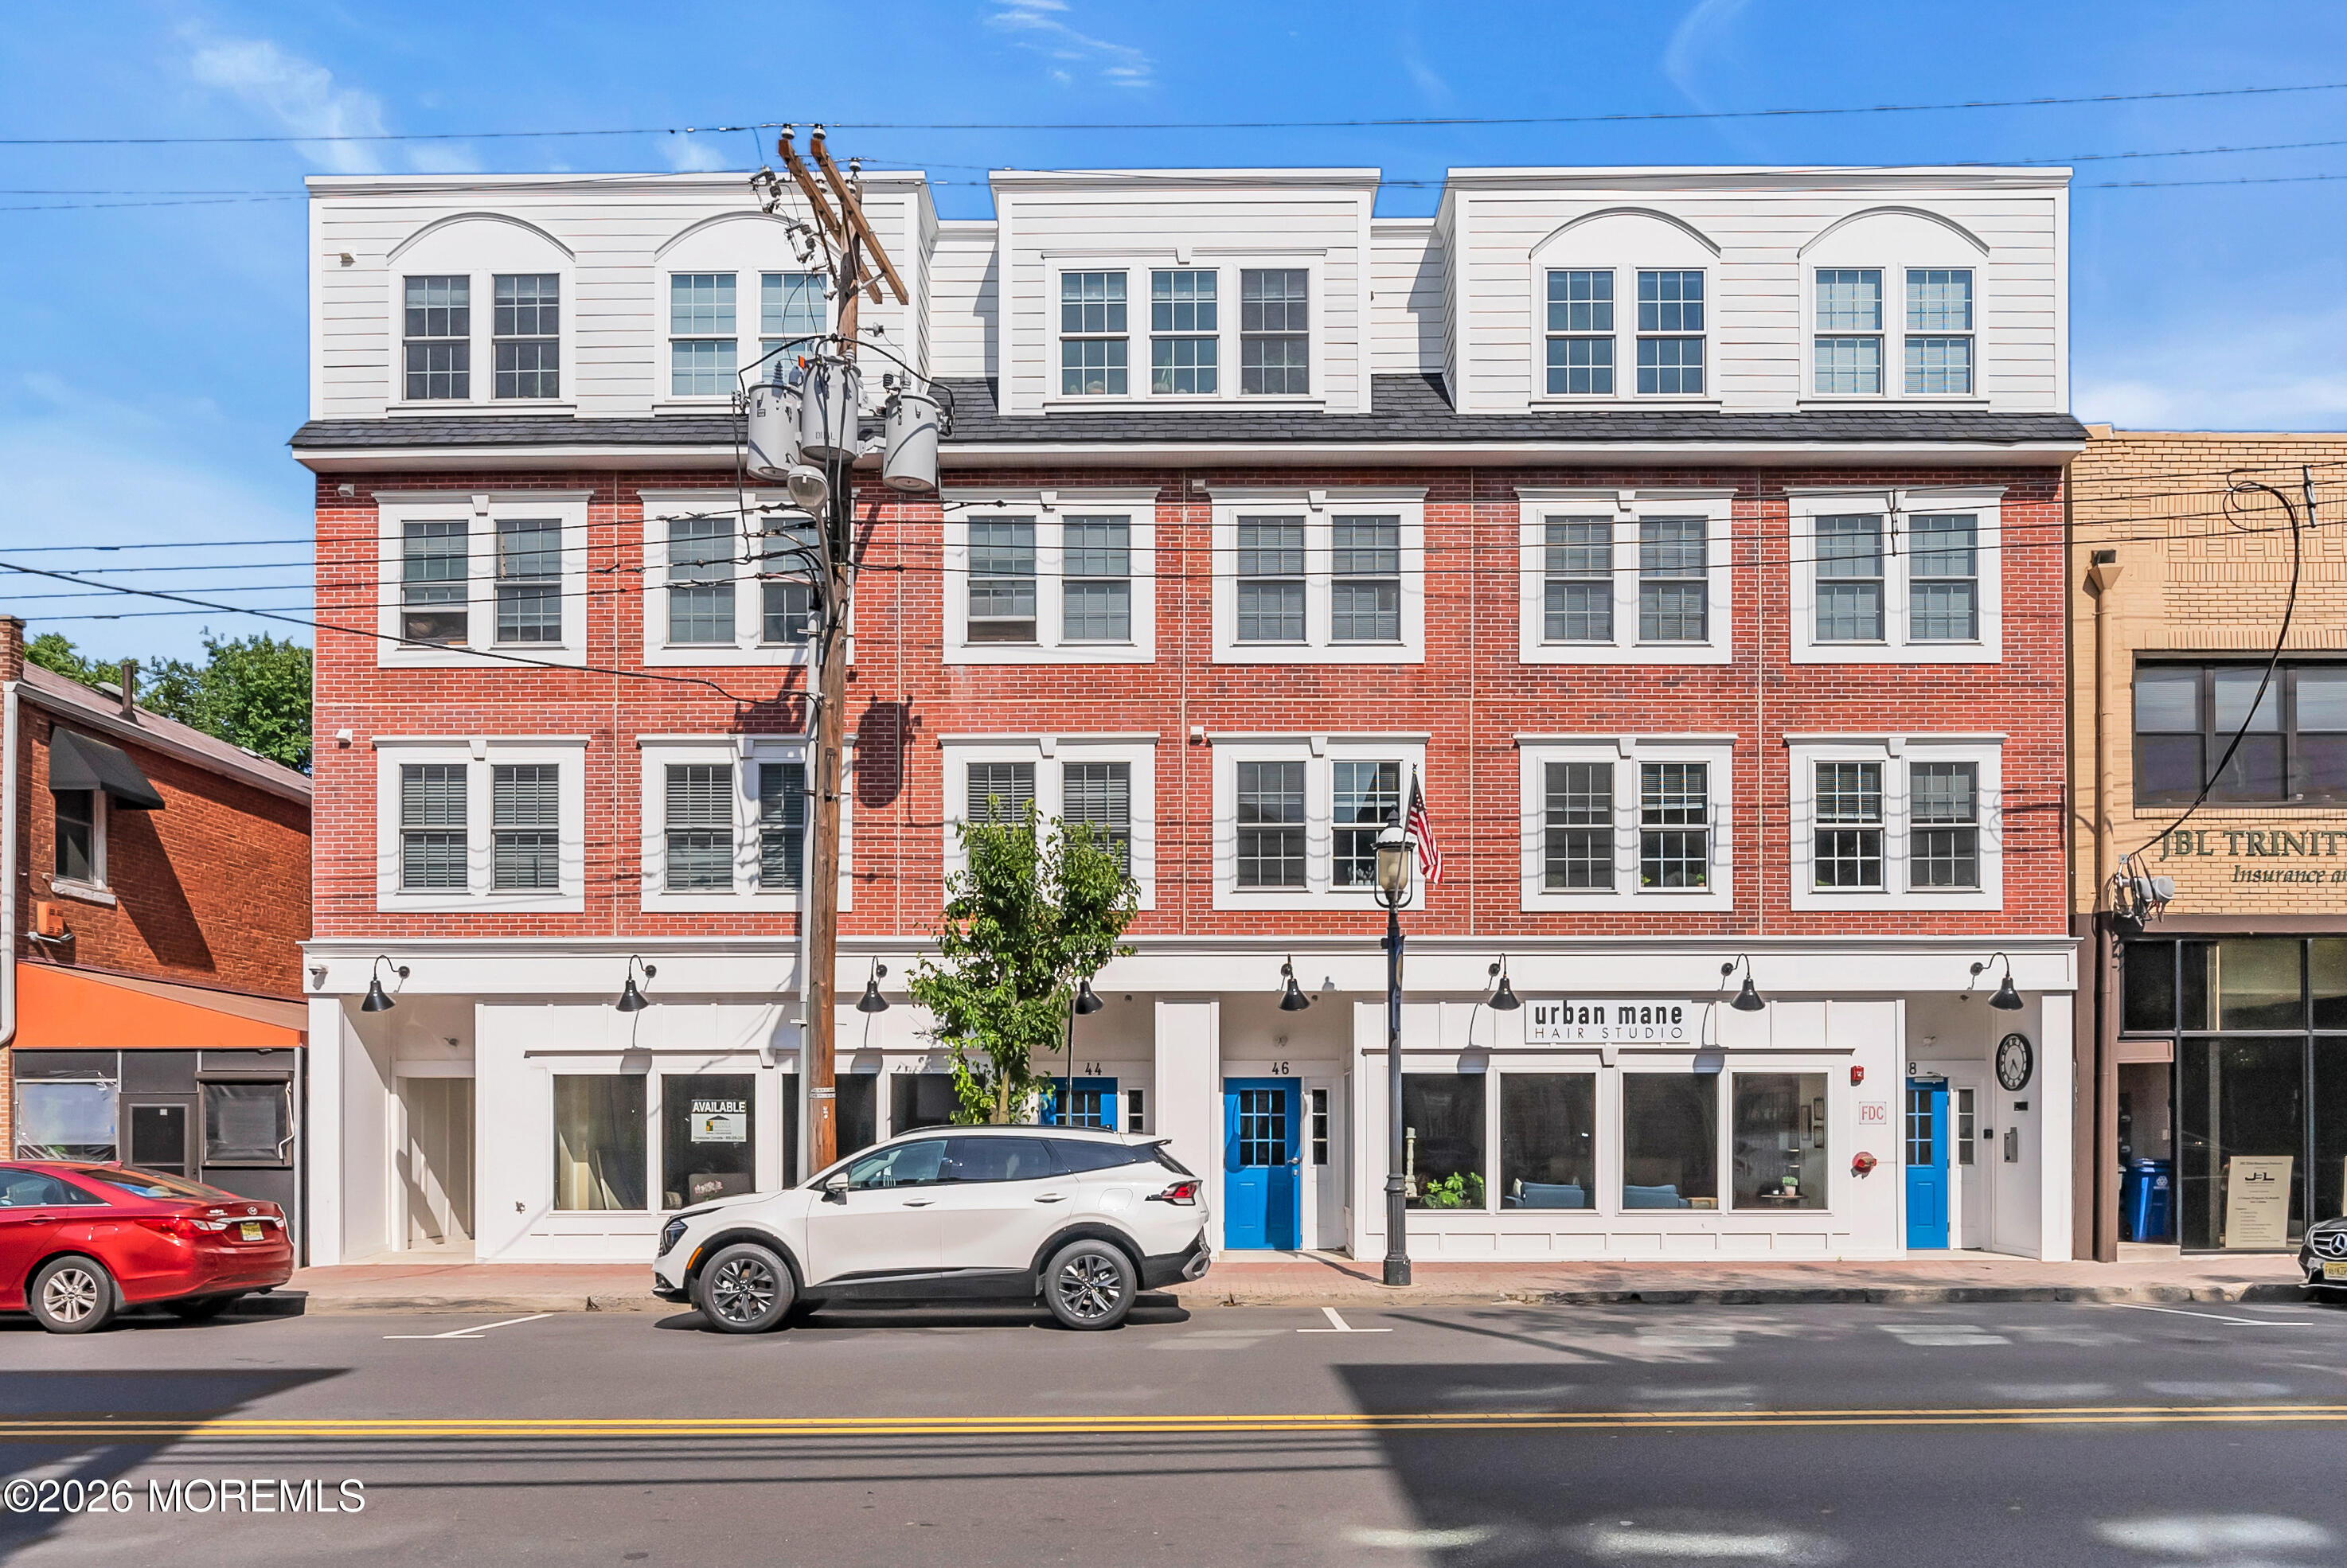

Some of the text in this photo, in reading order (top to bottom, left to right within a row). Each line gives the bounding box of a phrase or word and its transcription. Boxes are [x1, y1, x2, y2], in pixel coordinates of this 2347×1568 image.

[2159, 829, 2347, 862] JBL TRINIT
[2232, 864, 2326, 883] Insurance
[1535, 999, 1682, 1025] urban mane
[1535, 1027, 1682, 1039] HAIR STUDIO
[1085, 1063, 1102, 1075] 44
[1271, 1061, 1290, 1075] 46
[692, 1101, 746, 1113] AVAILABLE
[1861, 1106, 1884, 1121] FDC
